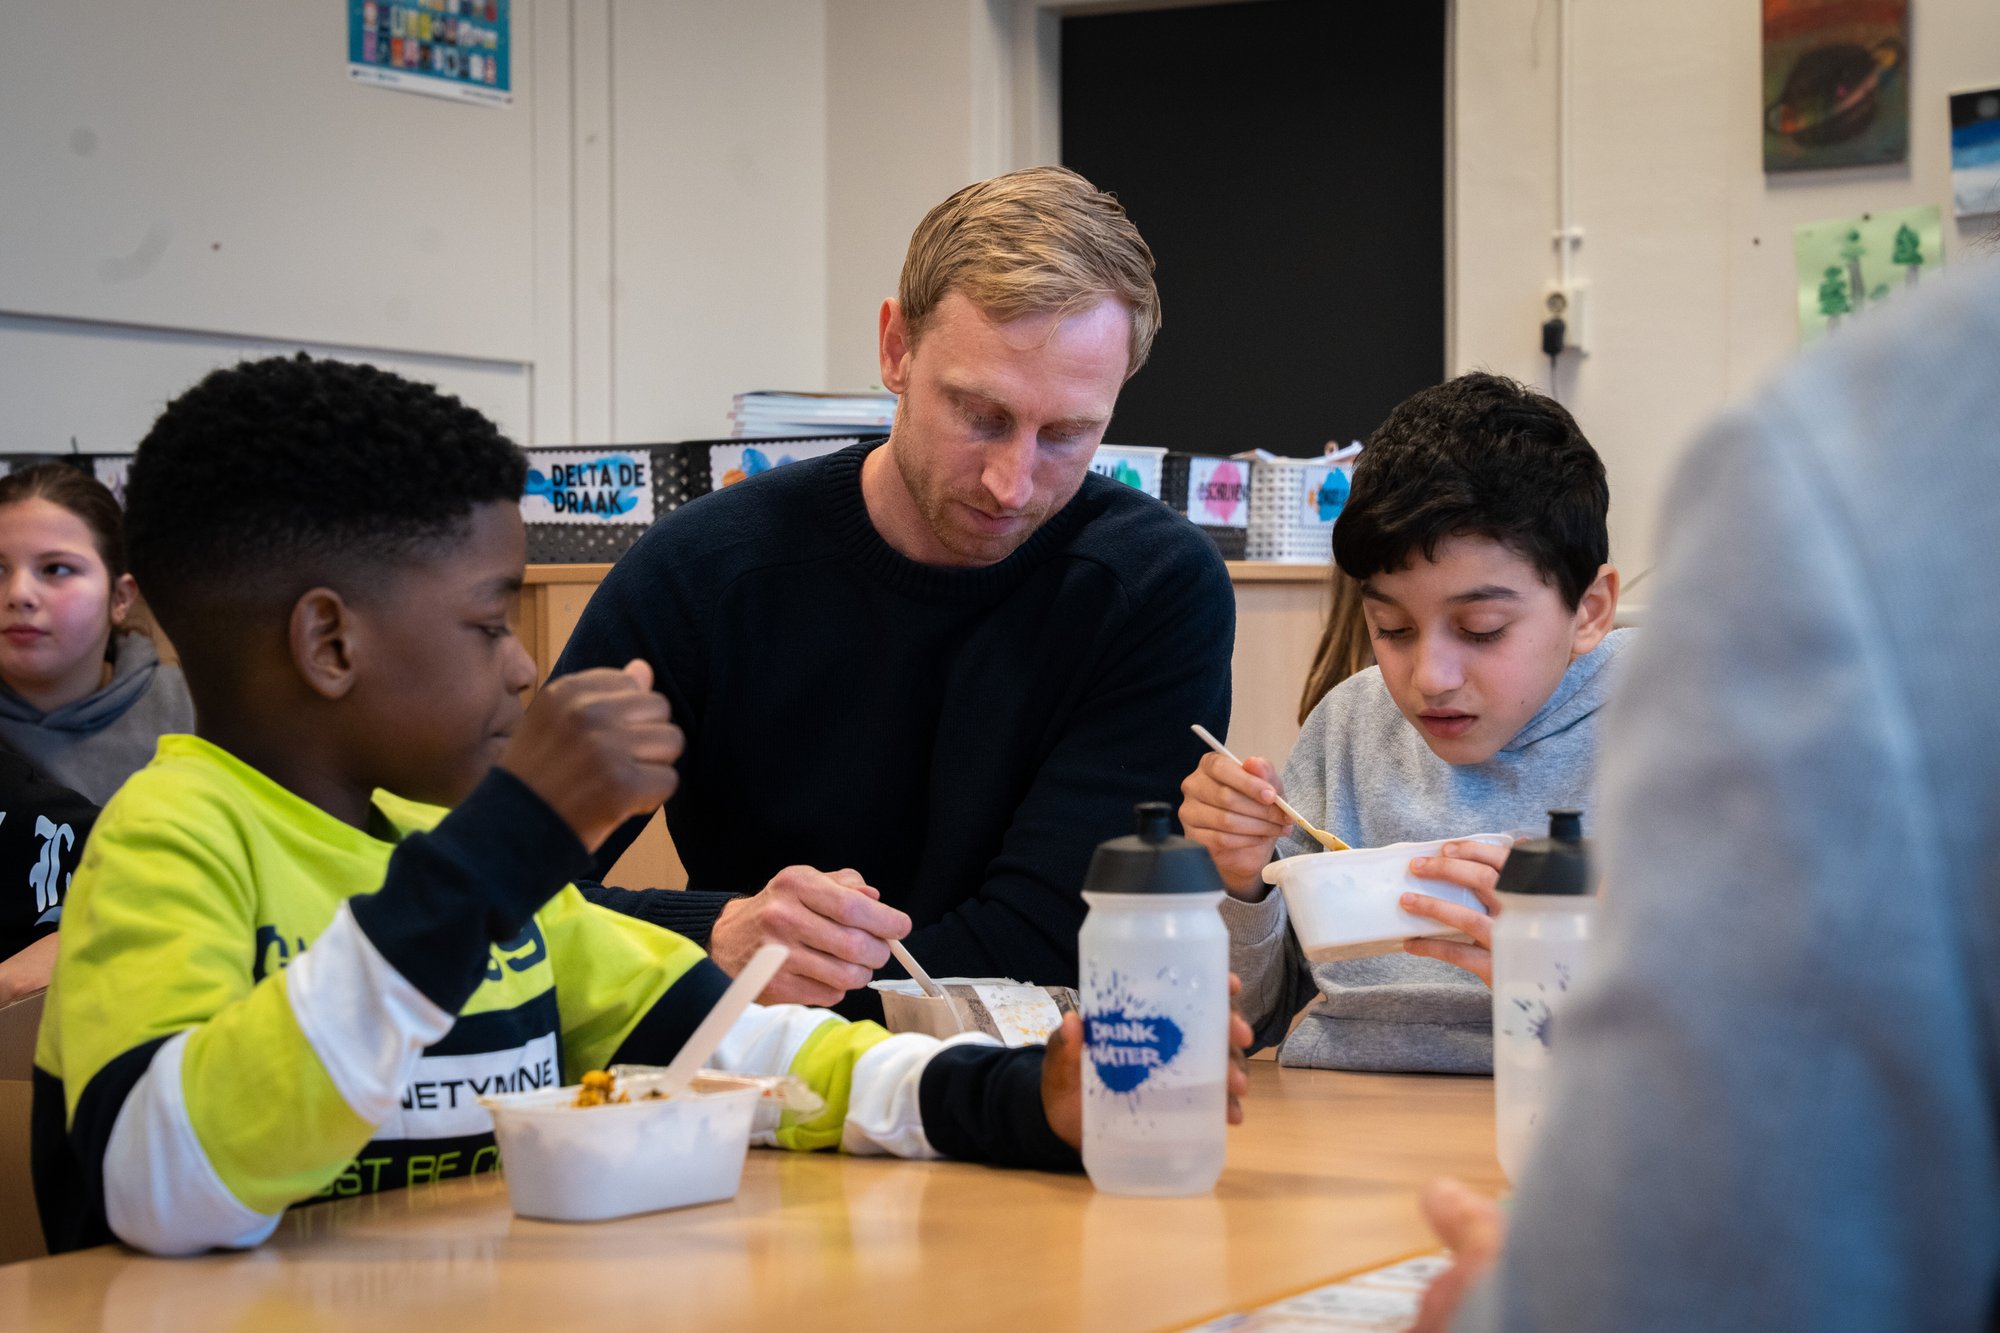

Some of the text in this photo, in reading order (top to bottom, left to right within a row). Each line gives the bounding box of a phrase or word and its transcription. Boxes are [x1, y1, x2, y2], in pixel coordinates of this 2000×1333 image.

[551, 463, 646, 487] DELTA DE
[553, 490, 624, 513] DRAAK
[1091, 1021, 1159, 1043] DRINK
[1090, 1041, 1165, 1068] WATER
[320, 1157, 393, 1196] ST
